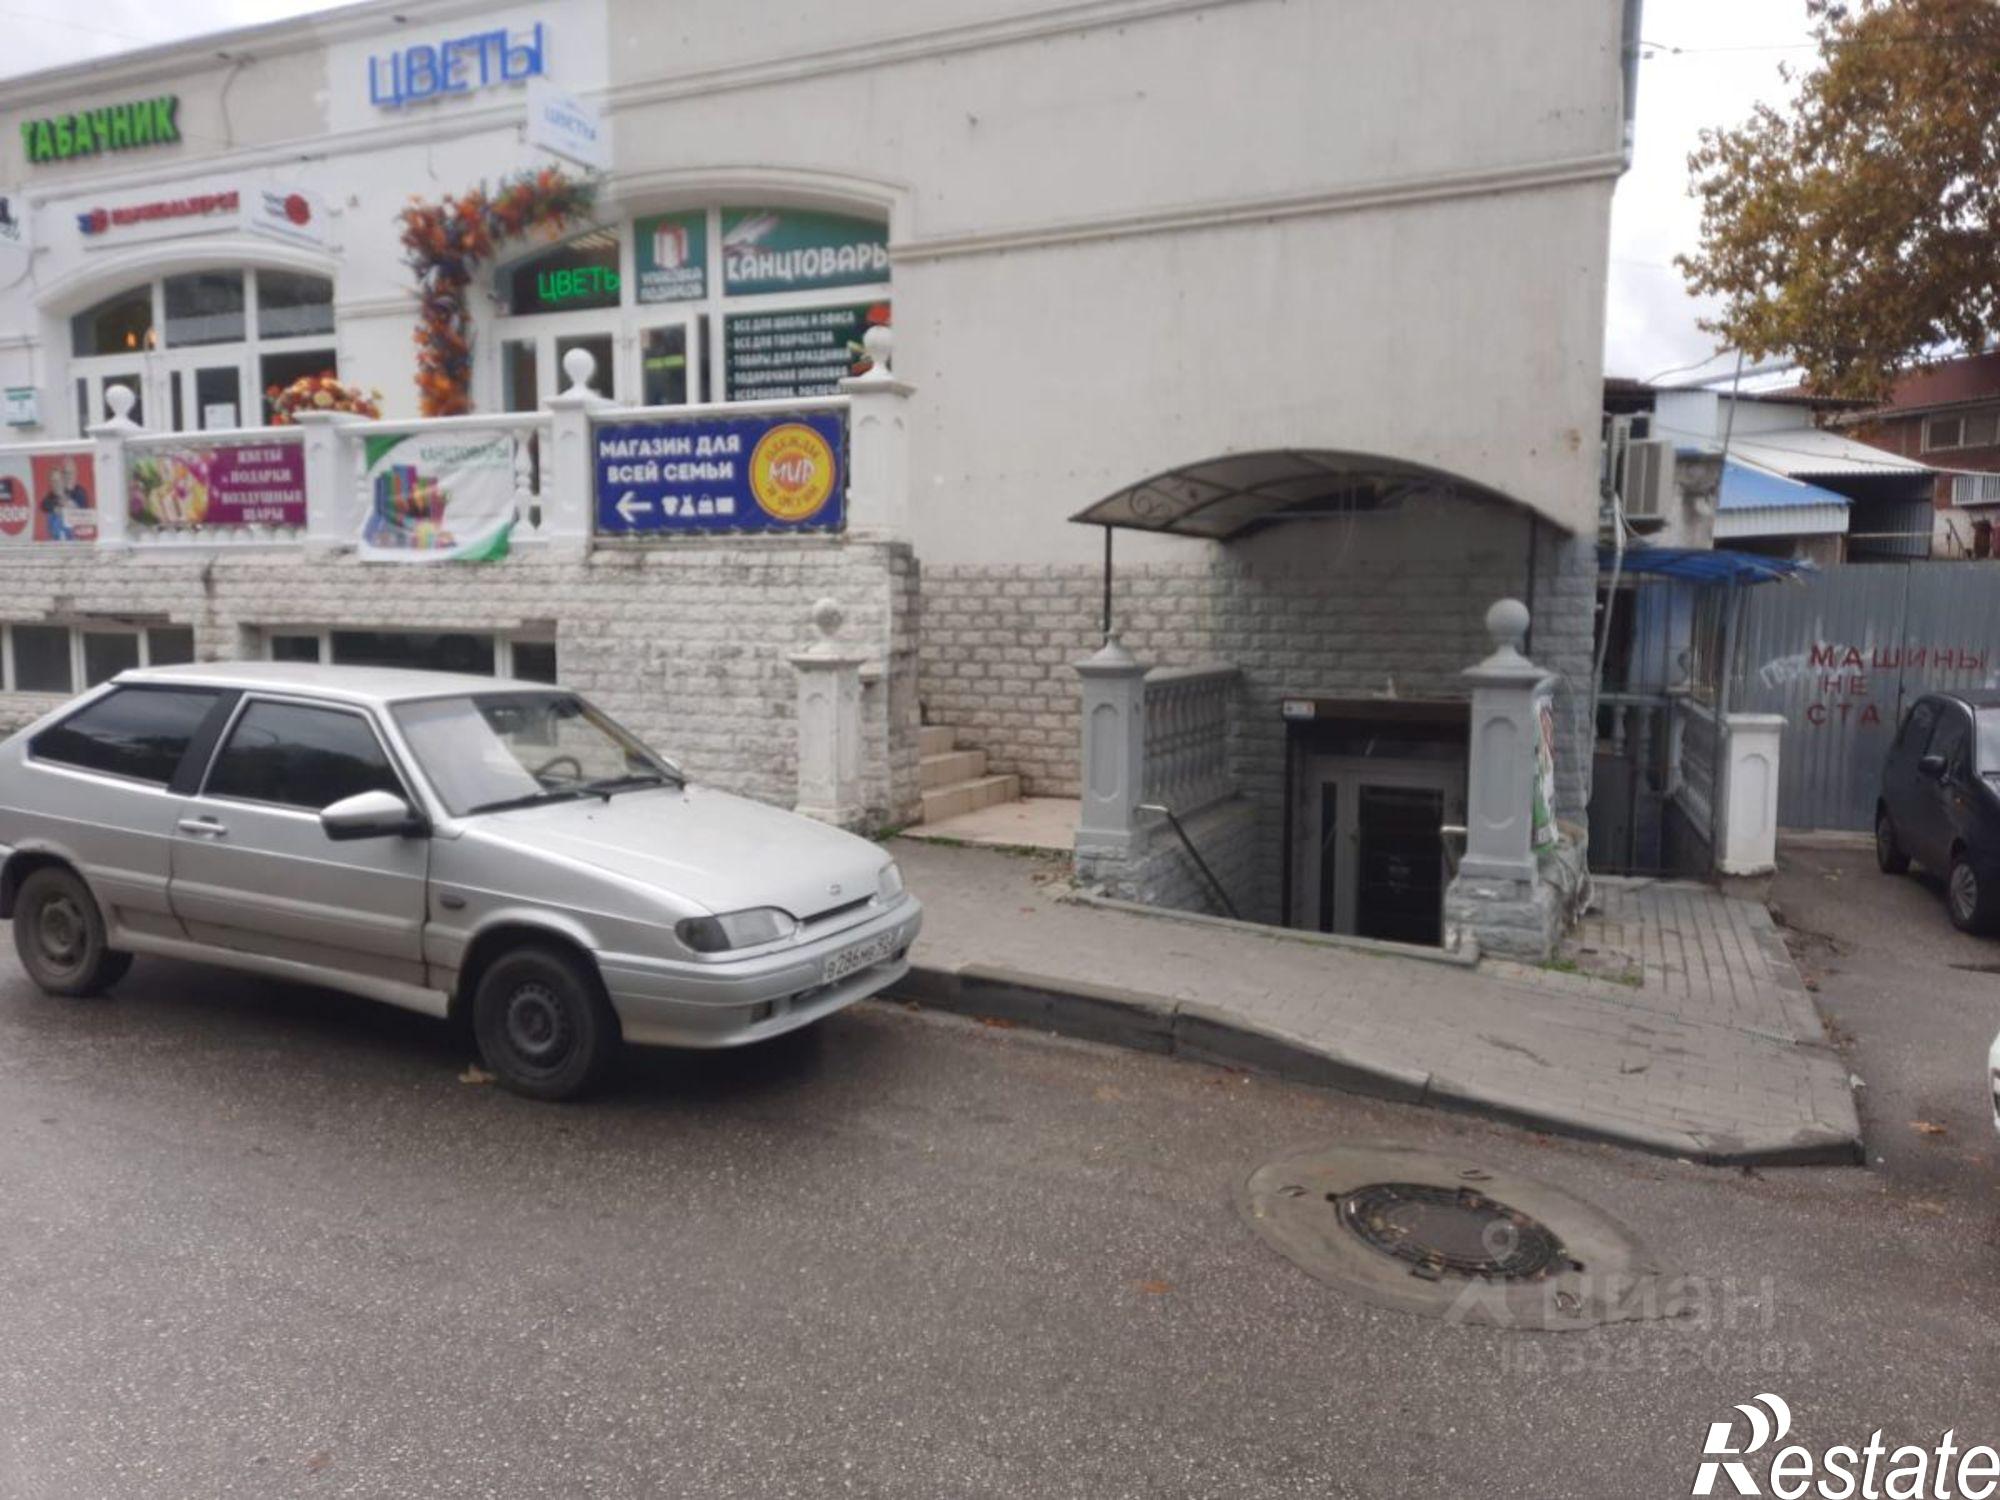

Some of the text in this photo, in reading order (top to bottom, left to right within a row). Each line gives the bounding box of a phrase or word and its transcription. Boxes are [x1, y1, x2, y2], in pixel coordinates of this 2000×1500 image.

[369, 22, 543, 105] ЦВЕТЫ
[20, 96, 181, 163] ТАБАЧНИК
[600, 437, 691, 458] МАГАЗИН
[696, 434, 741, 456] ДЛЯ
[607, 460, 734, 483] ВСЕЙ СЕМЬИ
[1809, 643, 1988, 670] МАШИНЫ
[1822, 674, 1868, 695] НЕ
[1807, 702, 1881, 726] СТА
